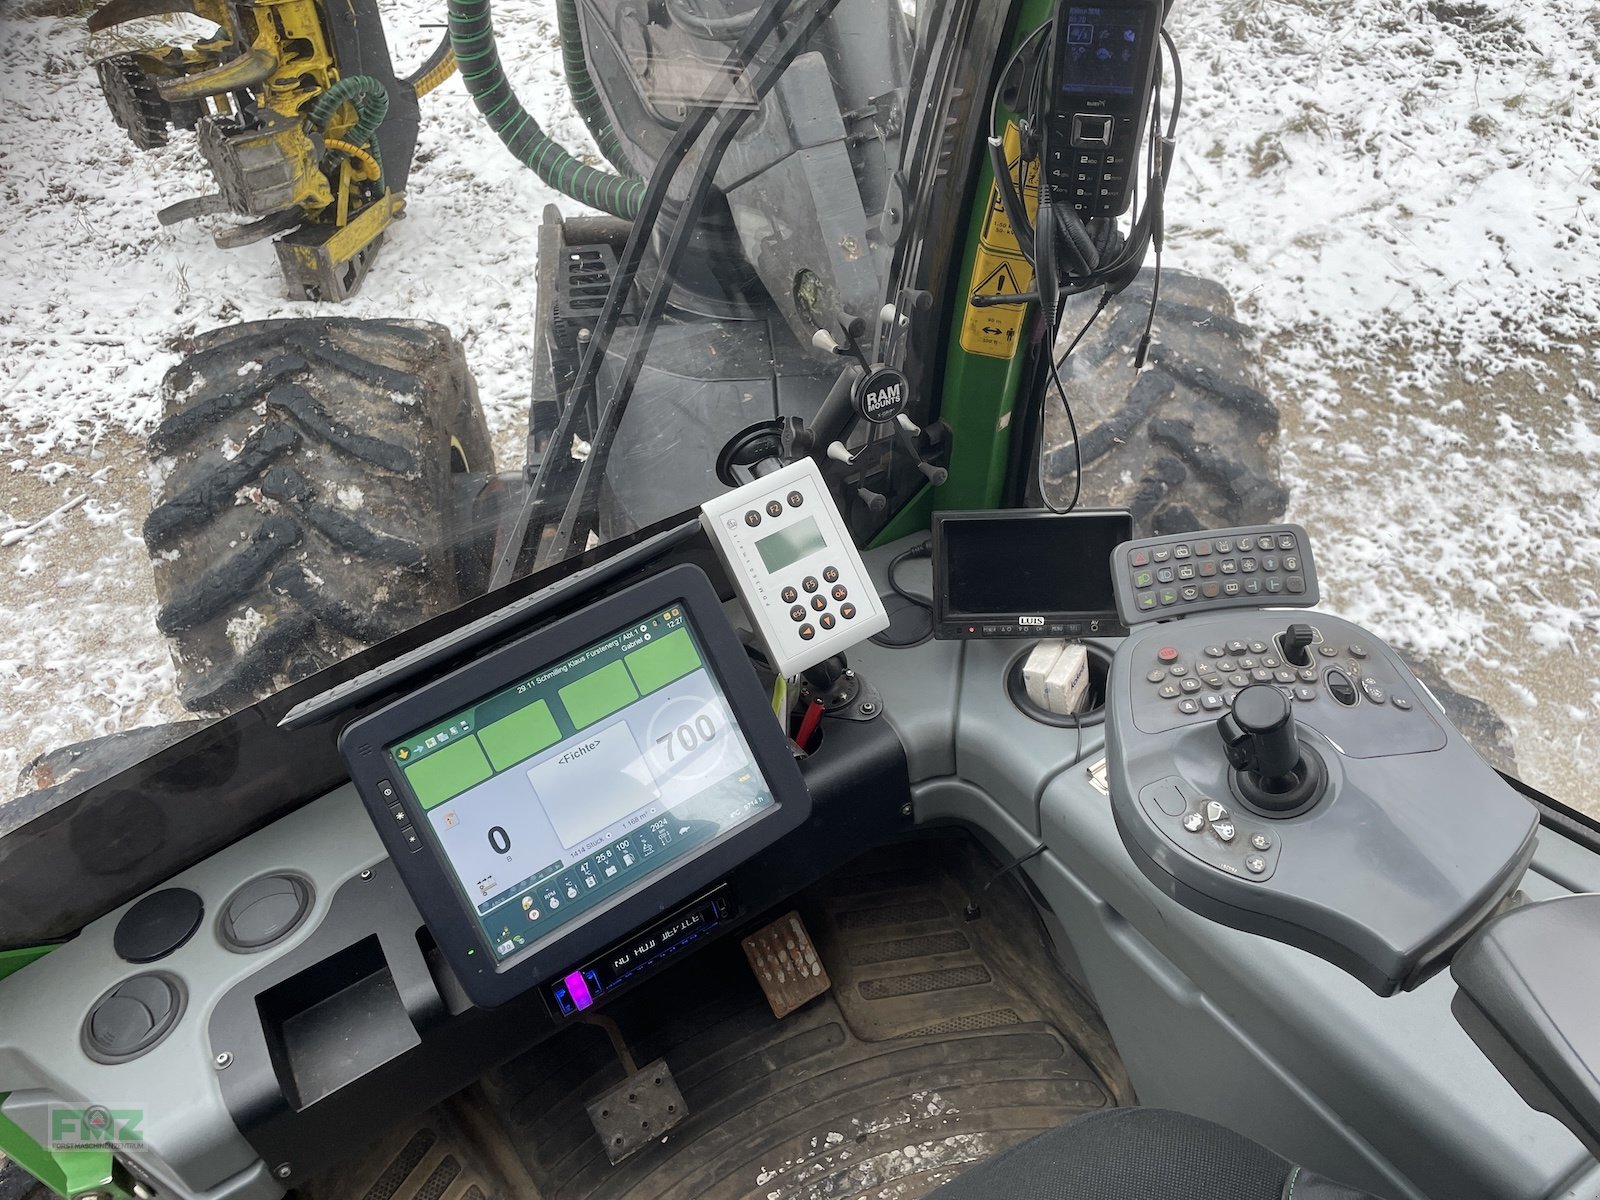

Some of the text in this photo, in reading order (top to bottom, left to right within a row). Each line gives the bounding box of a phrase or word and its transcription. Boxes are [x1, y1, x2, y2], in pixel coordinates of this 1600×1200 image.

[1080, 156, 1088, 164] 2
[866, 384, 900, 406] RAM
[868, 396, 900, 412] MOUNTS
[790, 494, 800, 504] F3
[770, 504, 780, 513] F2
[749, 514, 758, 523] F1
[826, 570, 836, 579] F6
[806, 580, 815, 589] F5
[784, 590, 794, 600] F4
[835, 589, 845, 598] ok
[792, 608, 804, 618] esc
[666, 616, 683, 629] 12:27
[621, 637, 643, 652] Gabriel
[536, 666, 568, 685] Schmilling
[567, 655, 586, 668] Klaus
[656, 714, 716, 762] 700
[558, 740, 601, 765] <Fichte>
[650, 818, 668, 832] 2924
[488, 826, 511, 854] 0
[616, 840, 630, 851] 100
[570, 847, 586, 858] 1414
[580, 862, 589, 872] 47
[544, 890, 557, 900] RPM
